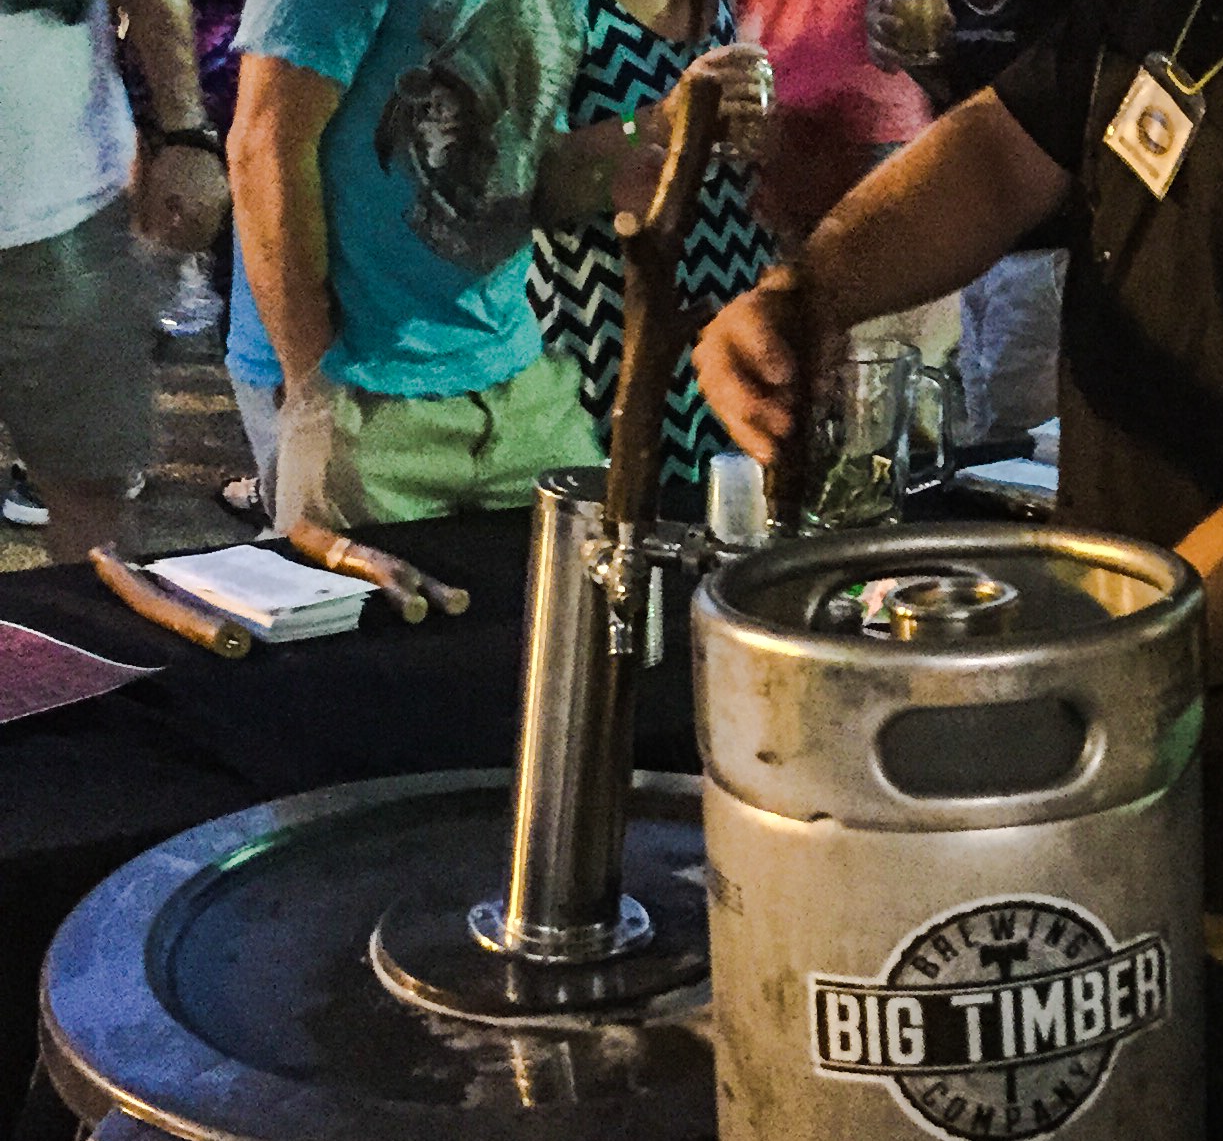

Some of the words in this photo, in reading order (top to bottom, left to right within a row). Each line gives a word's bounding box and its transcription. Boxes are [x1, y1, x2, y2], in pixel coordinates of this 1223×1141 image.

[911, 910, 1089, 979] BREWING
[825, 991, 927, 1066] BIG
[949, 946, 1164, 1063] TIMBER
[922, 1056, 1090, 1136] COMPANY
